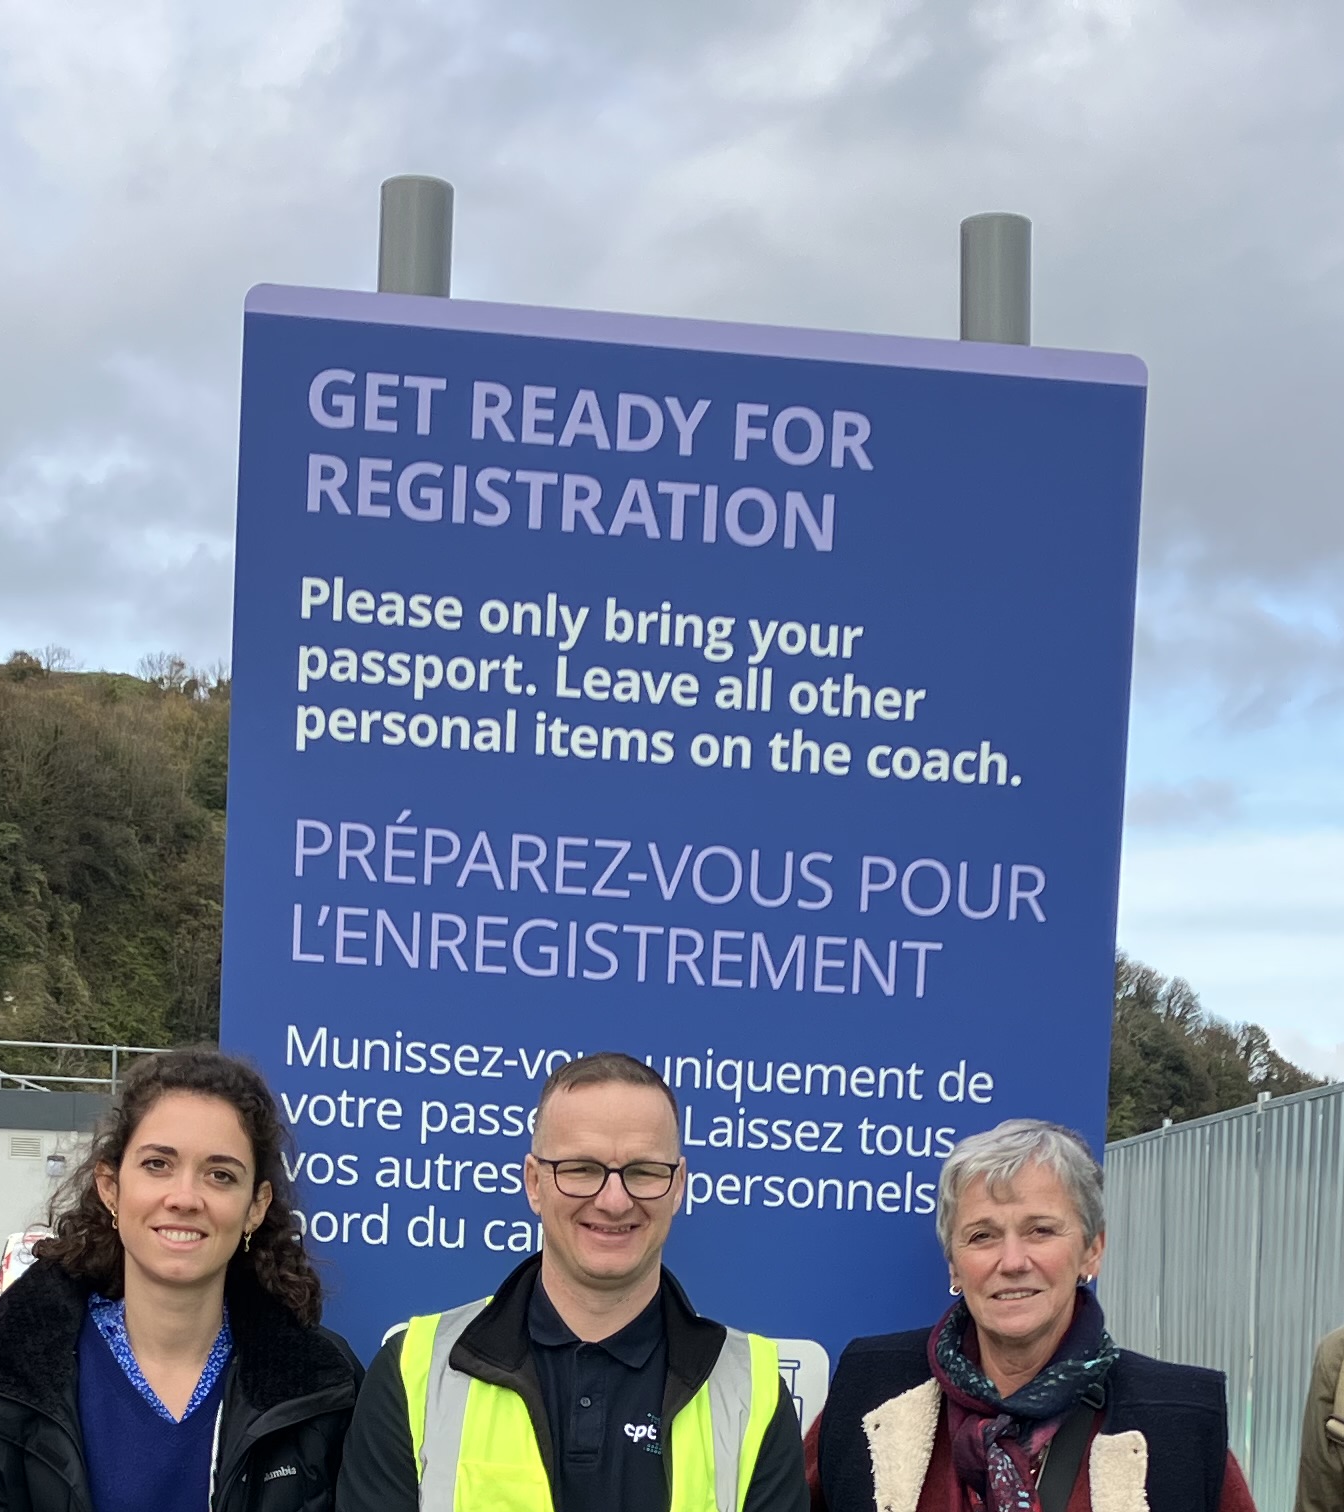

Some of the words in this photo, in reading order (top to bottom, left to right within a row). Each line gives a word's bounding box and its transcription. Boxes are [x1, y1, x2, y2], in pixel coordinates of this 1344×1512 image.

[308, 369, 447, 435] GET
[471, 381, 711, 456] READY
[734, 403, 873, 470] FOR
[307, 453, 835, 551] REGISTRATION
[301, 576, 463, 630] Please
[479, 592, 590, 651] only
[604, 597, 736, 663] bring
[747, 619, 864, 665] your
[297, 645, 537, 701] passport.
[556, 655, 699, 707] Leave
[714, 666, 773, 712] all
[789, 673, 927, 721] other
[295, 705, 517, 753] personal
[535, 711, 675, 764] items
[690, 733, 752, 769] on
[768, 728, 851, 776] the
[866, 740, 1022, 787] coach.
[295, 809, 833, 909] PRÉPAREZ-VOUS
[860, 856, 1045, 922] POUR
[292, 903, 943, 998] L’ENREGISTREMENT
[286, 1024, 585, 1080] Munissez-vo
[938, 1059, 994, 1104] de
[280, 1089, 403, 1131] votre
[684, 1105, 844, 1153] Laissez
[857, 1117, 956, 1159] tous
[280, 1151, 359, 1186] vos
[375, 1153, 523, 1195] autres
[685, 1171, 936, 1215] personnels
[407, 1204, 465, 1249] du
[263, 1464, 297, 1482] umbia
[623, 1423, 657, 1443] cpt
